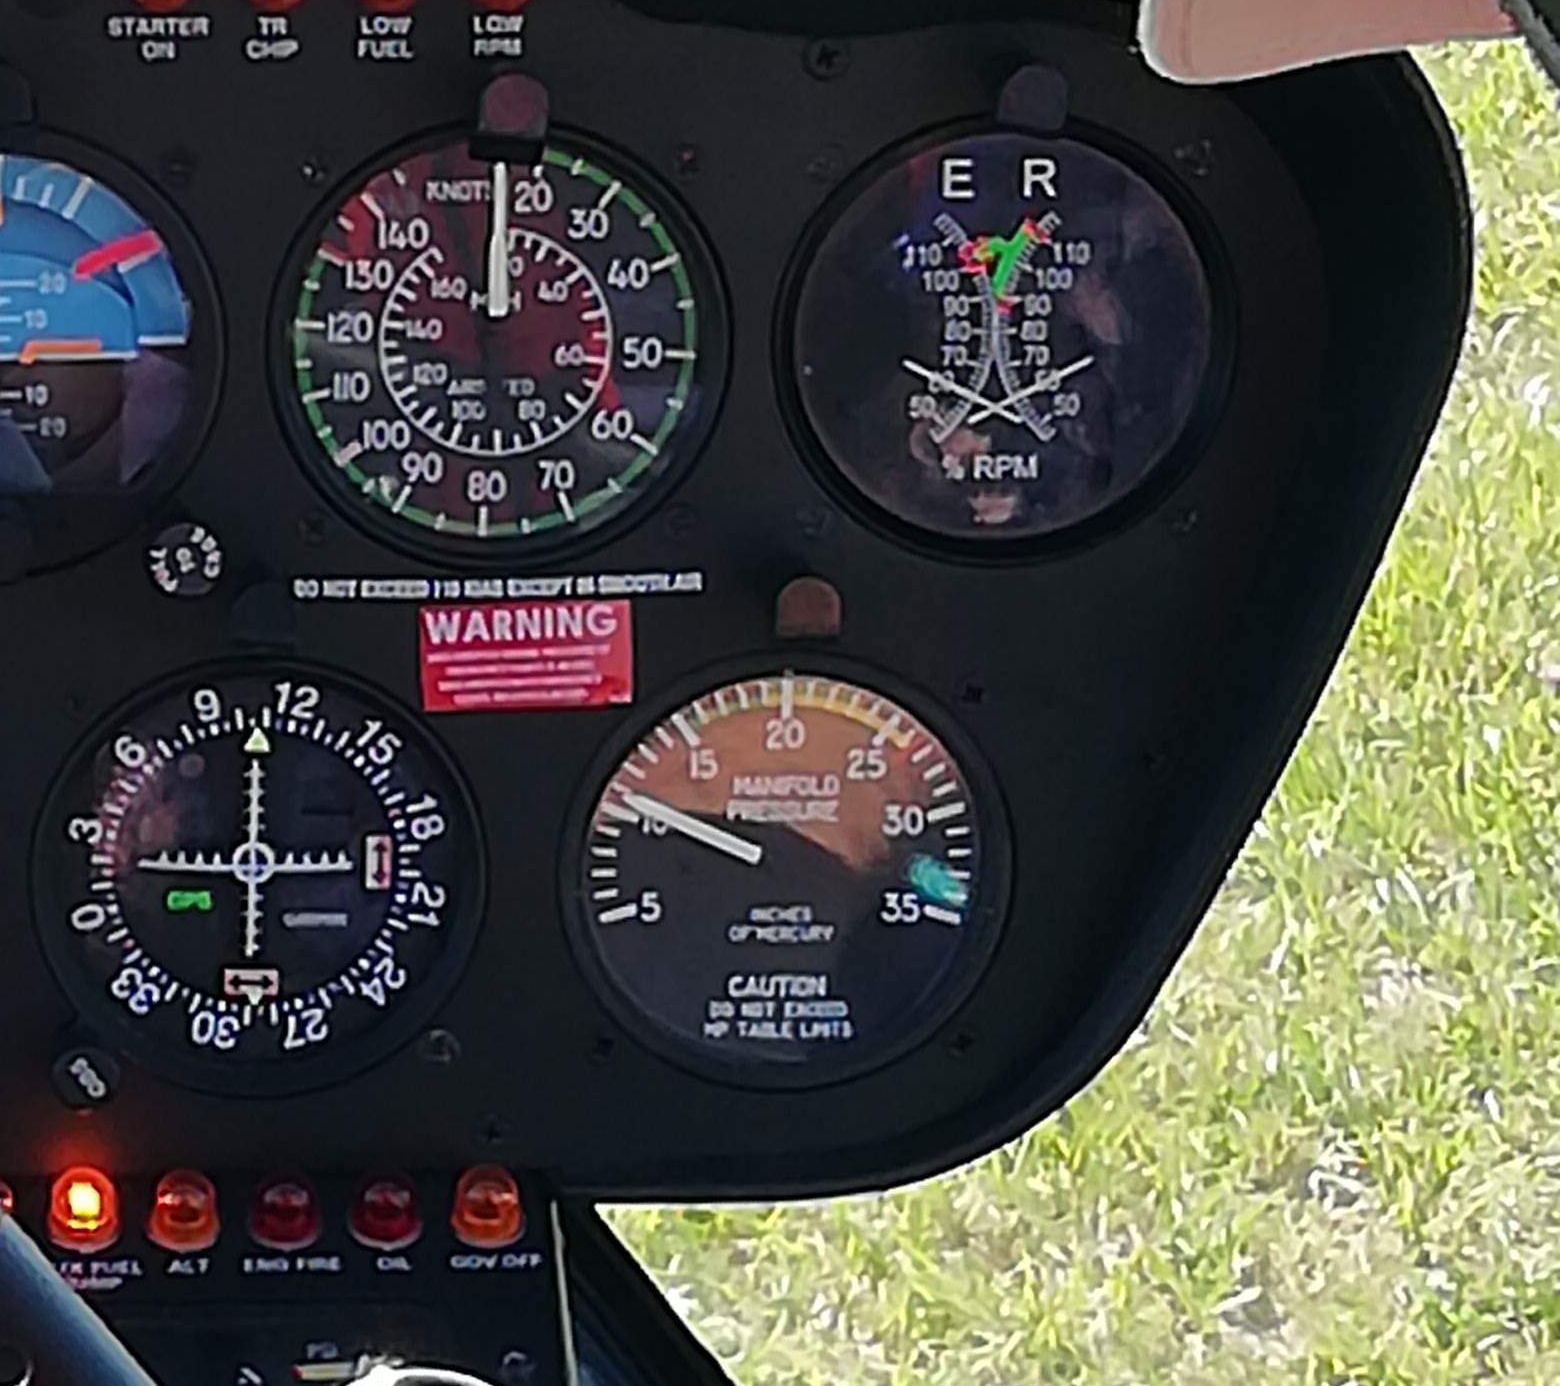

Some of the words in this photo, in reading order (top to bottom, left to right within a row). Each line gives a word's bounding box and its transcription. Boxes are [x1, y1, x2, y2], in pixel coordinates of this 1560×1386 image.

[107, 18, 211, 38] STARTER
[258, 16, 288, 36] TR
[360, 16, 414, 37] LOW
[473, 15, 524, 35] LOW
[140, 40, 177, 60] ON
[245, 39, 300, 60] CHIP
[357, 38, 415, 60] FUEL
[473, 38, 523, 58] RPM
[942, 159, 976, 199] E
[1023, 159, 1057, 198] R
[514, 181, 553, 214] 20
[377, 219, 429, 250] 140
[568, 206, 609, 240] 30
[344, 258, 394, 291] 130
[607, 256, 650, 290] 40
[922, 270, 959, 291] 100
[1036, 268, 1073, 289] 100
[325, 312, 374, 343] 120
[404, 316, 443, 339] 140
[554, 344, 584, 367] 60
[622, 336, 663, 370] 50
[941, 345, 968, 366] 70
[1023, 345, 1050, 366] 70
[330, 371, 371, 402] 110
[412, 362, 448, 385] 120
[25, 385, 49, 405] 10
[519, 399, 546, 421] 80
[451, 400, 486, 421] 100
[591, 408, 633, 441] 60
[362, 418, 411, 451] 100
[402, 451, 443, 484] 90
[539, 459, 575, 489] 70
[942, 458, 966, 480] %
[973, 455, 1039, 479] RPM
[467, 471, 507, 502] 80
[425, 603, 617, 645] WARNING
[193, 689, 221, 723] 9
[274, 682, 320, 721] 12
[114, 735, 146, 768] 6
[356, 720, 403, 765] 15
[765, 723, 806, 750] 20
[688, 749, 720, 778] 15
[846, 749, 887, 779] 25
[733, 775, 840, 796] MANIFOLD
[68, 818, 103, 845] 3
[406, 794, 446, 840] 18
[881, 806, 925, 835] 30
[408, 881, 447, 927] 21
[640, 892, 662, 922] 5
[880, 892, 920, 924] 35
[110, 966, 161, 1014] 33
[360, 957, 407, 1006] 24
[728, 975, 827, 998] CAUTION
[191, 1012, 241, 1049] 30
[283, 1009, 329, 1049] 27
[450, 1254, 498, 1270] GOV
[501, 1253, 542, 1269] OFF
